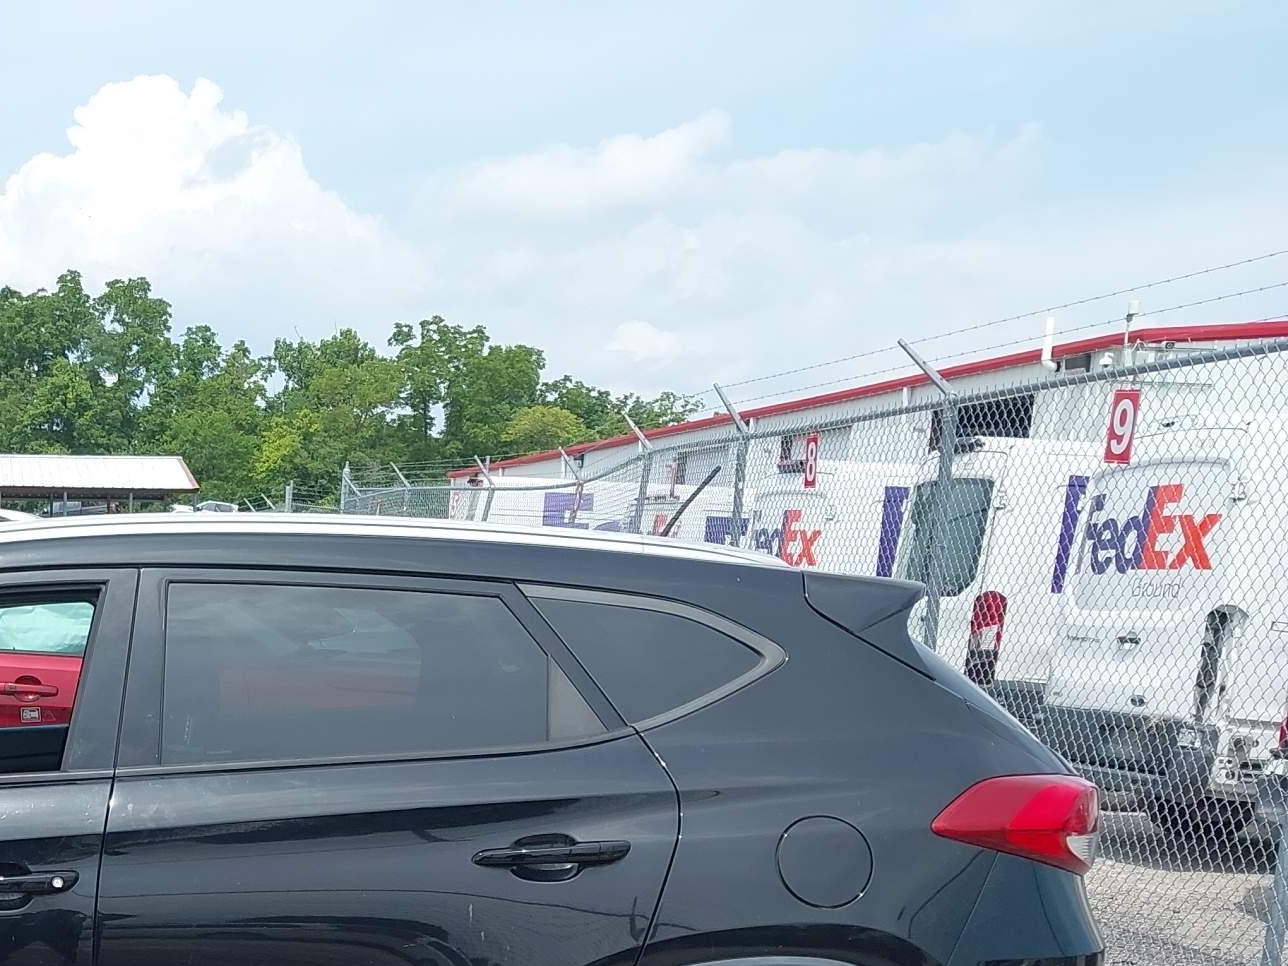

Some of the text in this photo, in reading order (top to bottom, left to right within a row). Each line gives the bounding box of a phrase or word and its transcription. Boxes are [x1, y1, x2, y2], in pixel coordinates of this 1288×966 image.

[1109, 398, 1136, 455] 9
[805, 441, 817, 482] 8
[1075, 484, 1222, 575] FedEx
[1132, 576, 1182, 598] Ground
